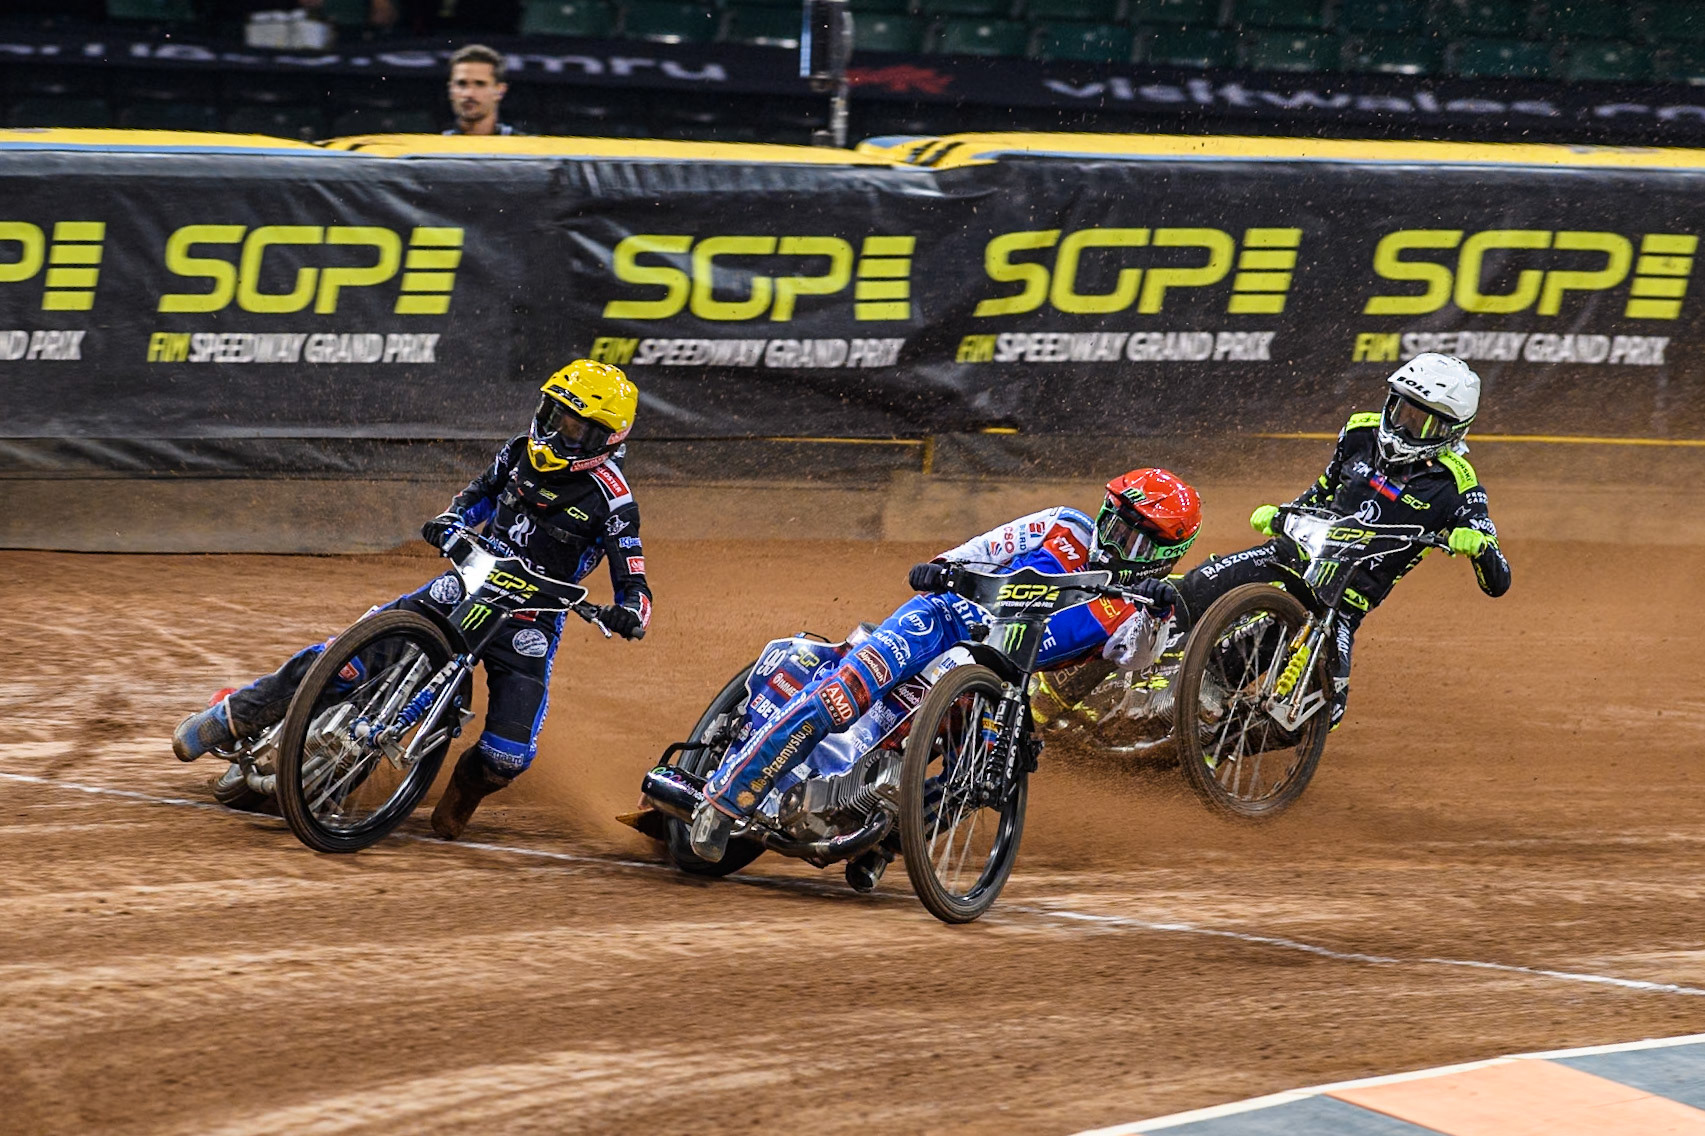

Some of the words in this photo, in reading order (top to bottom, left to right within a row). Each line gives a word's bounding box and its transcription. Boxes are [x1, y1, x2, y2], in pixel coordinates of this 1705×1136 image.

[25, 330, 87, 360] PRIX
[188, 332, 306, 363] SPEEDWAY
[304, 333, 384, 363] GRAND
[382, 333, 441, 363] PRIX
[633, 338, 768, 366] SPEEDWAY
[765, 338, 849, 368] GRAND
[846, 338, 906, 368] PRIX
[994, 332, 1129, 362] SPEEDWAY
[1126, 332, 1214, 362] GRAND
[1212, 331, 1276, 361] PRIX
[1524, 333, 1611, 364] GRAND
[1607, 335, 1670, 365] PRIX
[1053, 536, 1081, 560] FIM
[996, 584, 1048, 600] SGP
[755, 648, 788, 677] 99
[826, 686, 854, 721] AMD
